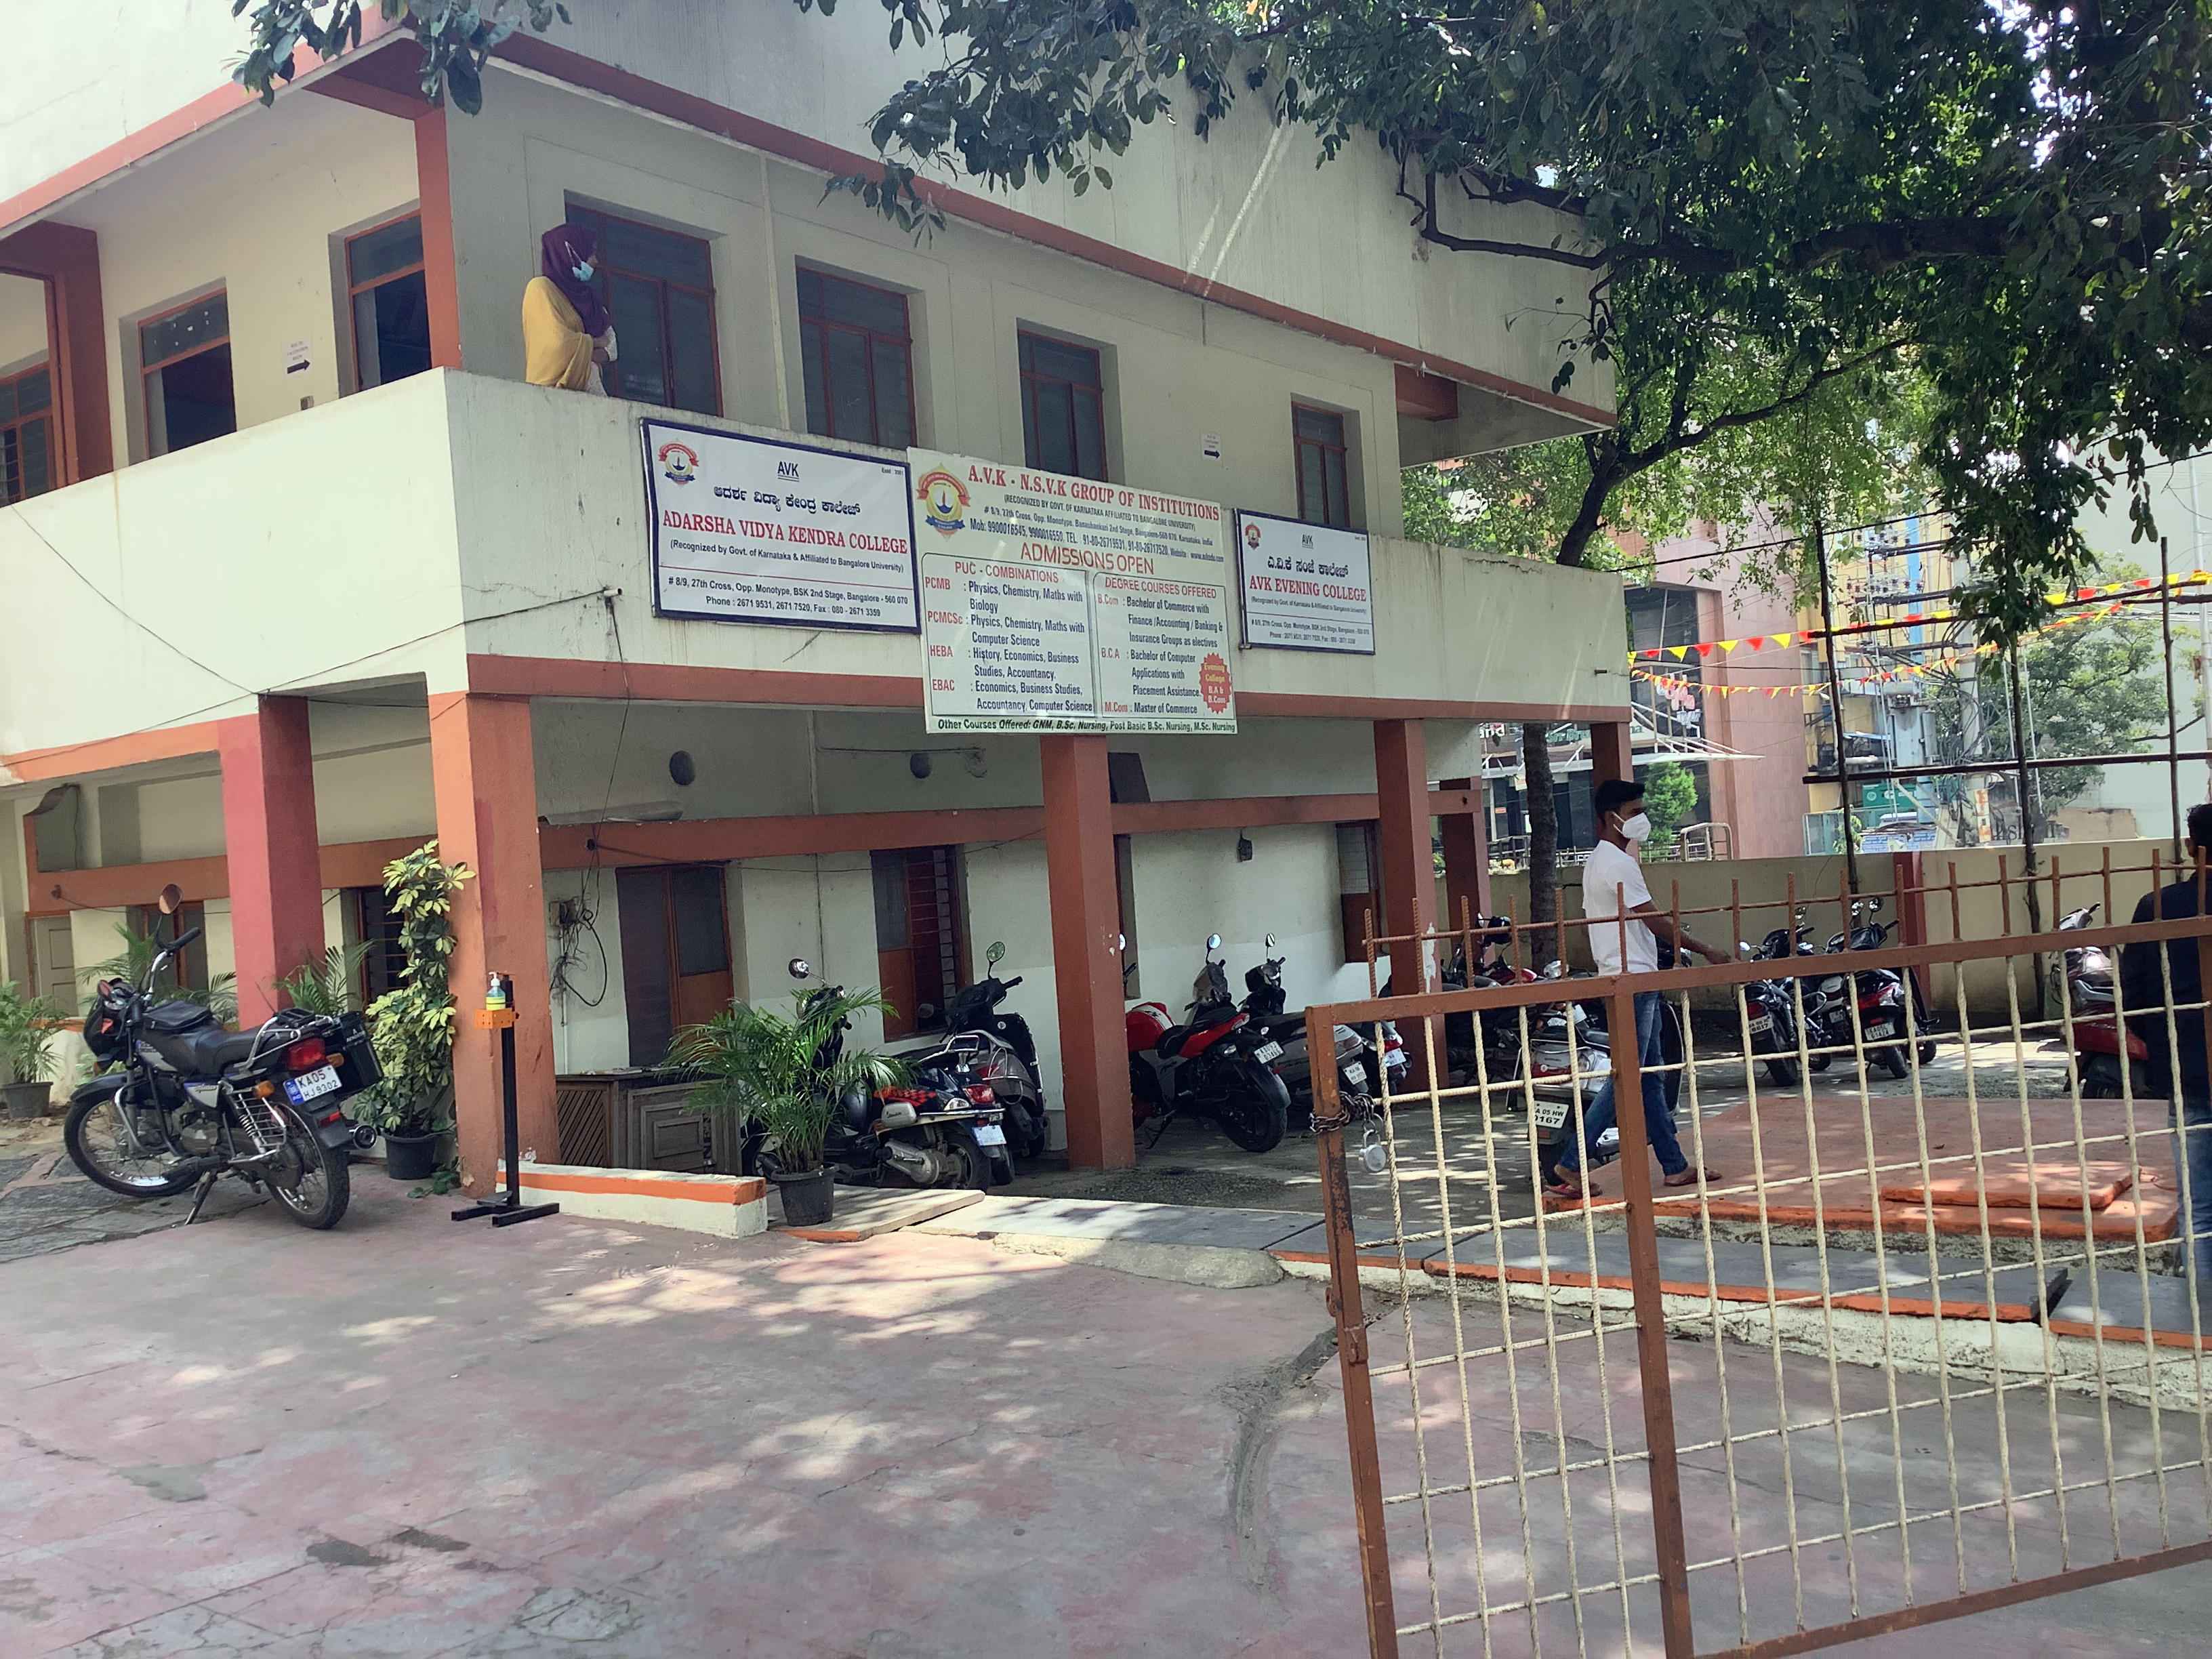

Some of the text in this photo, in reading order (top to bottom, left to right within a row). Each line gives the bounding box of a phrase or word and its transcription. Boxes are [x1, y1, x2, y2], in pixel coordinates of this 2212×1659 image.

[777, 461, 799, 477] AVK
[968, 465, 1006, 487] A.V.K
[1021, 474, 1066, 496] N.S.V.K
[1071, 482, 1114, 504] GROUP
[1118, 490, 1134, 507] OF
[1139, 494, 1219, 521] INSTITUTIONS
[785, 494, 817, 514] ಕೇಂದ್ರ
[1004, 494, 1195, 531] (RECOGNIZED BY GOVT. OF KARNATAKA AFFILIATED TO BANGALORE UNIVERSITY)
[663, 510, 907, 554] ADARSHA VIDYA KENDRA COLLEGE
[970, 518, 986, 531] Mob:
[1301, 534, 1313, 545] AVK
[670, 539, 716, 552] (Recognized
[718, 545, 727, 555] by
[729, 546, 747, 556] Govt.
[749, 548, 758, 556] of
[758, 550, 792, 560] Karnataka
[800, 554, 830, 565] Affiliated
[838, 558, 869, 569] Bangalore
[871, 561, 904, 573] University)
[1021, 541, 1154, 575] ADMISSIONS OPEN
[955, 562, 1059, 583] PUC COMBINATIONS
[676, 577, 689, 588] 8/9,
[691, 579, 708, 588] 27th
[710, 581, 734, 592] Cross,
[736, 583, 754, 594] Opp.
[756, 584, 792, 596] Monotype,
[794, 588, 808, 596] BSK
[810, 589, 823, 598] 2nd
[825, 590, 846, 601] Stage,
[847, 592, 880, 603] Bangalore
[897, 596, 908, 605] 070
[925, 576, 1083, 602] PCMB Physics, Chemistry, Maths with
[1105, 577, 1217, 599] DEGREE COURSES OFFERED
[1250, 575, 1367, 602] AVK EVENING COLLEGE
[706, 596, 731, 606] Phone
[737, 598, 754, 607] 2671
[756, 600, 775, 610] 9531,
[776, 602, 792, 610] 2671
[794, 602, 813, 613] 7520,
[813, 604, 827, 613] Fax
[849, 607, 864, 615] 2671
[970, 598, 998, 614] Biology
[1126, 596, 1155, 609] Bachelor
[1157, 600, 1163, 609] of
[1164, 600, 1195, 613] Commerce
[1196, 604, 1210, 614] with
[928, 611, 1085, 633] PCMCSc Physics, Chemistry, Maths with
[1128, 614, 1152, 626] Finance
[1195, 620, 1218, 633] Banking
[972, 632, 1040, 648] Computer Science
[1129, 632, 1218, 648] Insurance Groups as electives
[930, 645, 1079, 663] HEBA History, Economics, Business
[1130, 649, 1159, 661] Bachelor
[1160, 651, 1166, 661] of
[1167, 652, 1195, 663] Computer
[975, 665, 1057, 682] Studies, Accountancy.
[1132, 667, 1185, 679] Applications with
[932, 679, 1082, 695] EBAC Economics, Business Studies,
[1132, 684, 1166, 696] Placement
[1029, 699, 1063, 713] Computer
[1065, 700, 1092, 712] Science
[1134, 702, 1156, 713] Master
[1158, 702, 1164, 713] of
[1166, 703, 1197, 714] Commerce
[938, 719, 961, 730] Other
[964, 720, 996, 729] Courses
[999, 720, 1031, 730] Offered:
[1033, 721, 1054, 731] GNM,
[1078, 721, 1108, 732] Nursing,
[1110, 721, 1126, 730] Post
[1128, 722, 1145, 730] Basic
[1166, 722, 1193, 732] Nursing,
[1212, 723, 1235, 733] Nursing
[297, 1069, 326, 1088] KA05
[304, 1080, 338, 1099] HJ9302
